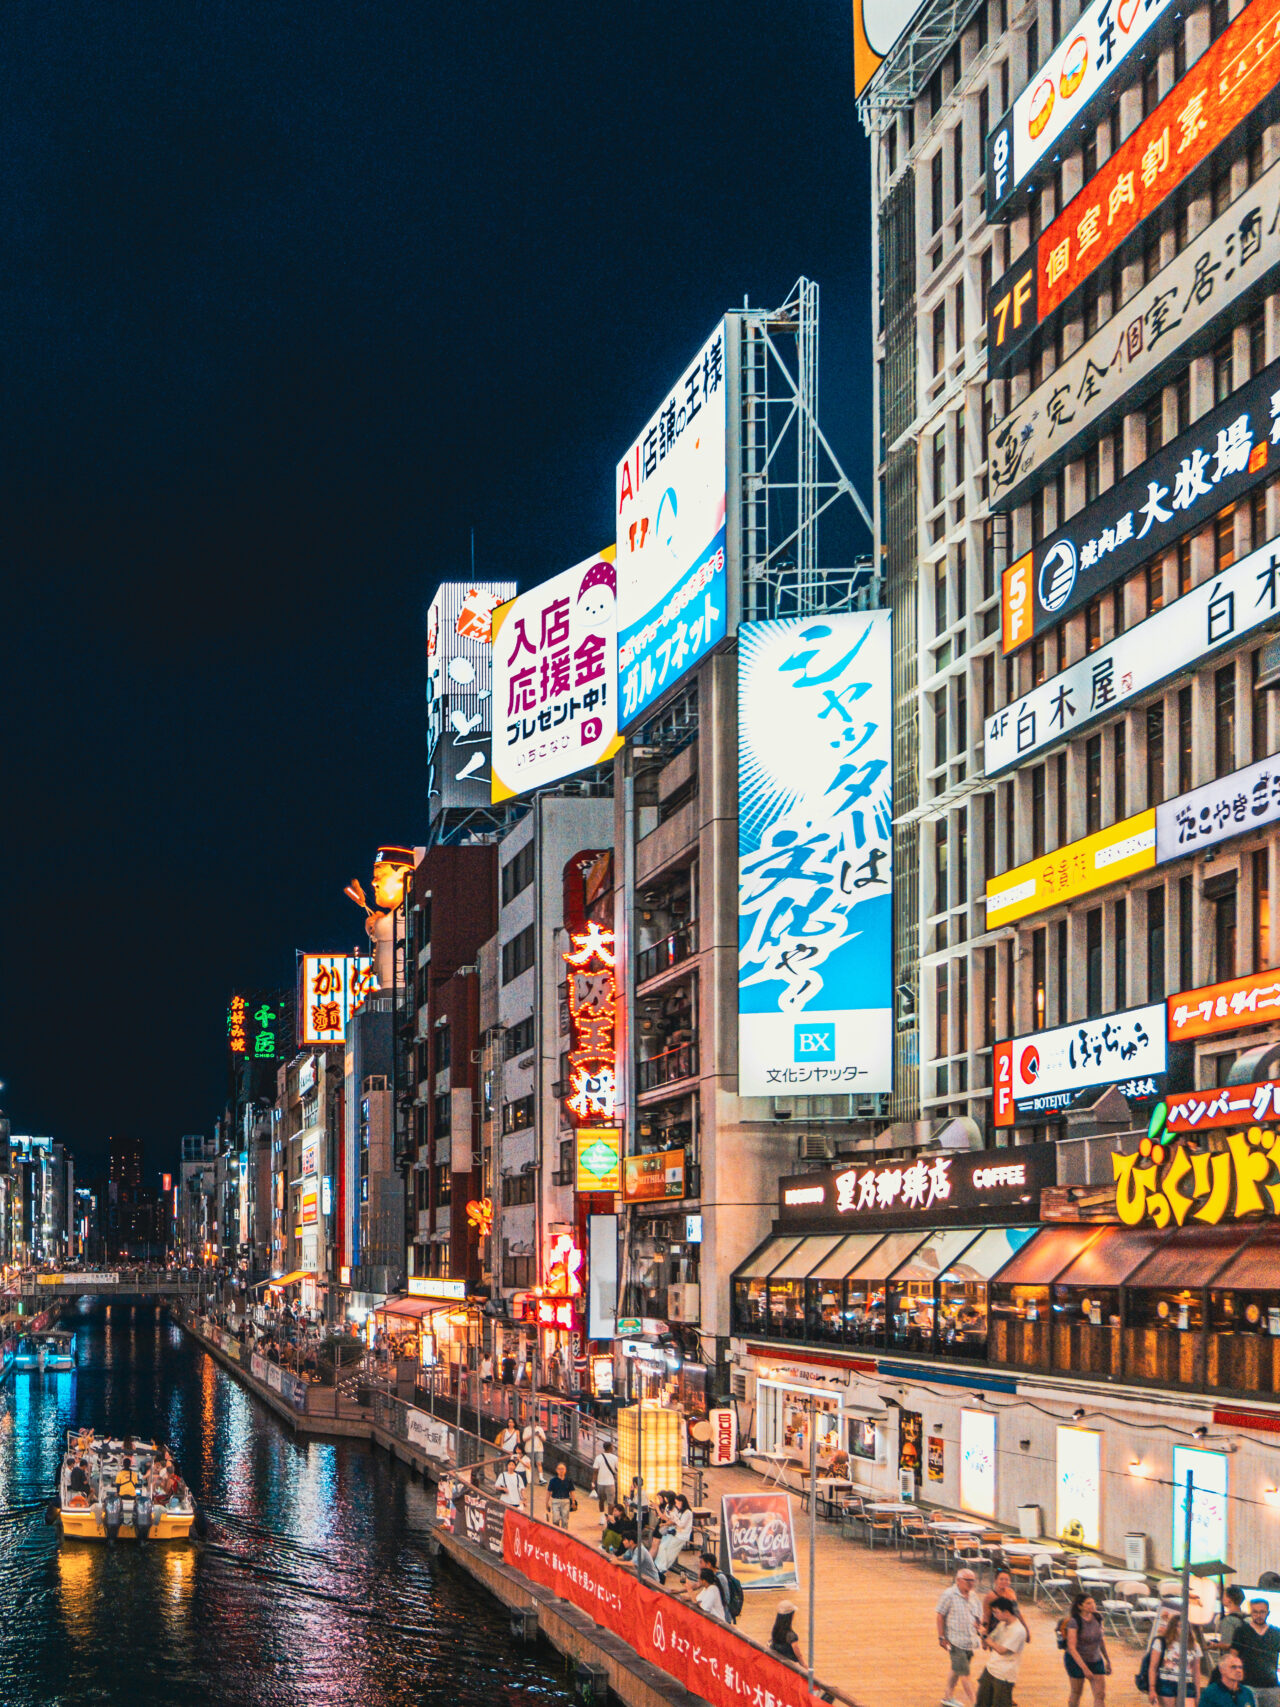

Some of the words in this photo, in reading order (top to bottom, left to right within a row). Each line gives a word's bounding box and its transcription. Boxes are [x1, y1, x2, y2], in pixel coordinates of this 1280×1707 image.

[993, 129, 1009, 200] 8F
[994, 269, 1033, 347] 7F
[1046, 195, 1280, 438] 完全個室居酒
[619, 338, 723, 514] AI店舗の王様
[1137, 414, 1254, 540] 大牧場
[1080, 512, 1134, 570] 焼肉屋
[507, 597, 570, 668] 入店
[1010, 568, 1027, 641] 5F
[507, 634, 606, 718] 応援金
[623, 593, 720, 717] ガルフネット
[506, 683, 606, 746] プレゼント中!
[990, 712, 1008, 742] 4F
[1016, 656, 1114, 754] 白木屋
[311, 964, 381, 995] かに
[230, 995, 246, 1051] お好み焼
[254, 1004, 276, 1052] 千房
[563, 920, 616, 1119] 大阪王将
[800, 1033, 830, 1052] BX
[999, 1055, 1010, 1115] 2F
[1033, 1092, 1071, 1110] BOTEJYU
[835, 1157, 952, 1213] 星乃珈琲店
[972, 1165, 1025, 1188] COFFEE
[718, 1413, 732, 1462] BURGER
